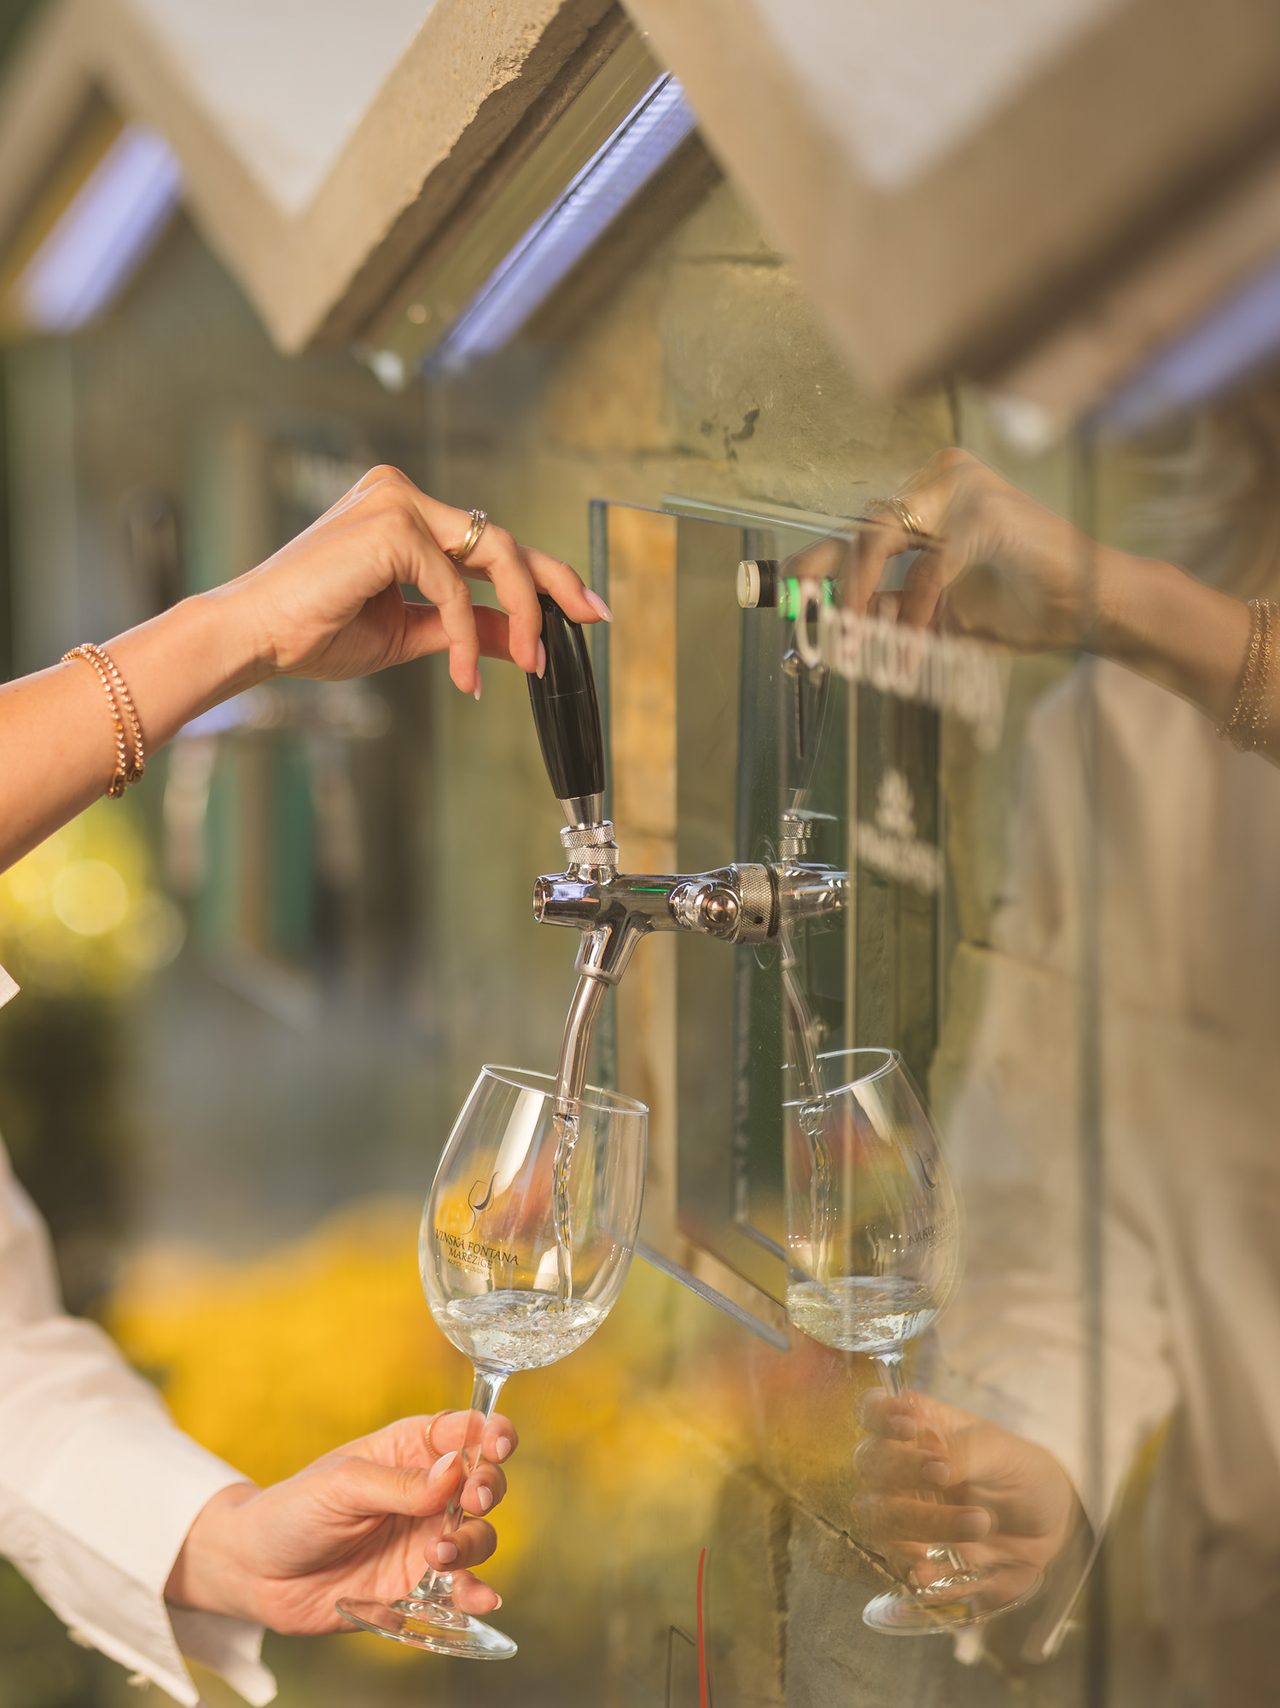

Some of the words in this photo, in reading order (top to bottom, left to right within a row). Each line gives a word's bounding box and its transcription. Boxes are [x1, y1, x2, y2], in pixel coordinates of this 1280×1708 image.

[436, 1229, 465, 1250] VINSKA
[467, 1242, 519, 1265] FONTANA
[449, 1248, 493, 1270] MAREZIGE
